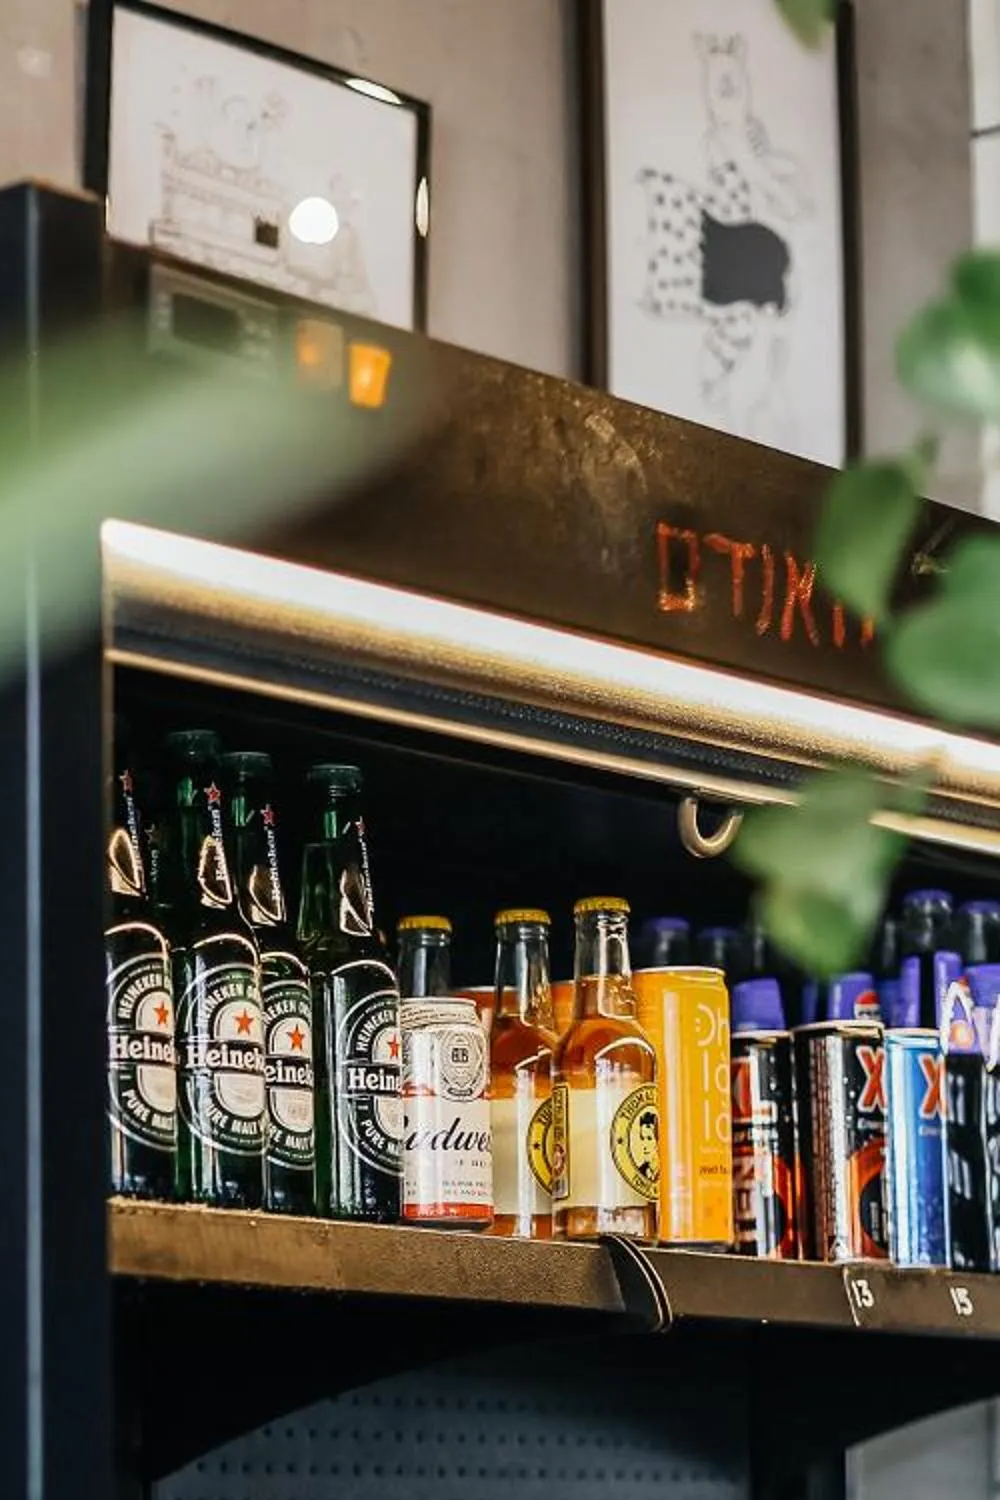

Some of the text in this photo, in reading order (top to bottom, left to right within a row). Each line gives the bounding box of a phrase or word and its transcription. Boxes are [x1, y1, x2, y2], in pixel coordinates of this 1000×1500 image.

[265, 1059, 313, 1086] einek
[403, 1115, 491, 1153] udwe
[851, 1279, 875, 1308] 13
